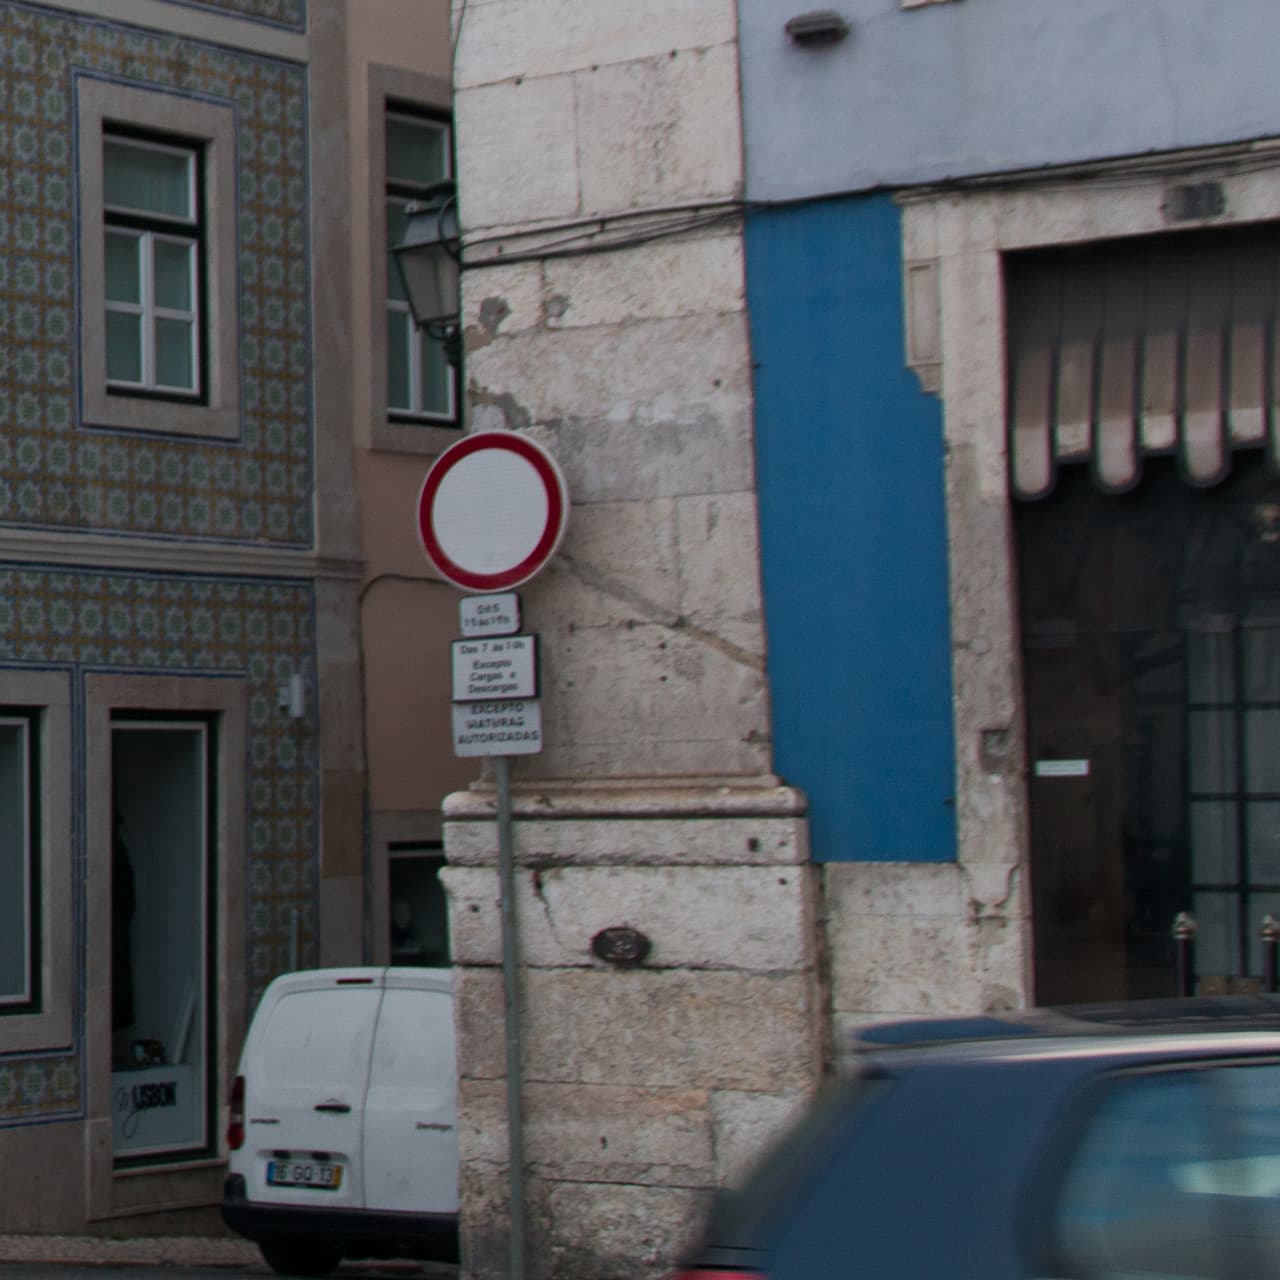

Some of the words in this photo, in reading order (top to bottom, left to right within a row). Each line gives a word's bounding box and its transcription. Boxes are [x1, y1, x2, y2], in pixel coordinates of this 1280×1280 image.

[460, 644, 478, 655] Das
[482, 643, 488, 653] 7
[472, 659, 512, 671] Excepto
[469, 672, 504, 683] Cargas
[468, 682, 518, 694] Descargas
[470, 703, 524, 715] EXCEPTO
[466, 716, 525, 729] VIATURAS
[458, 730, 539, 745] AUTORIZADAS
